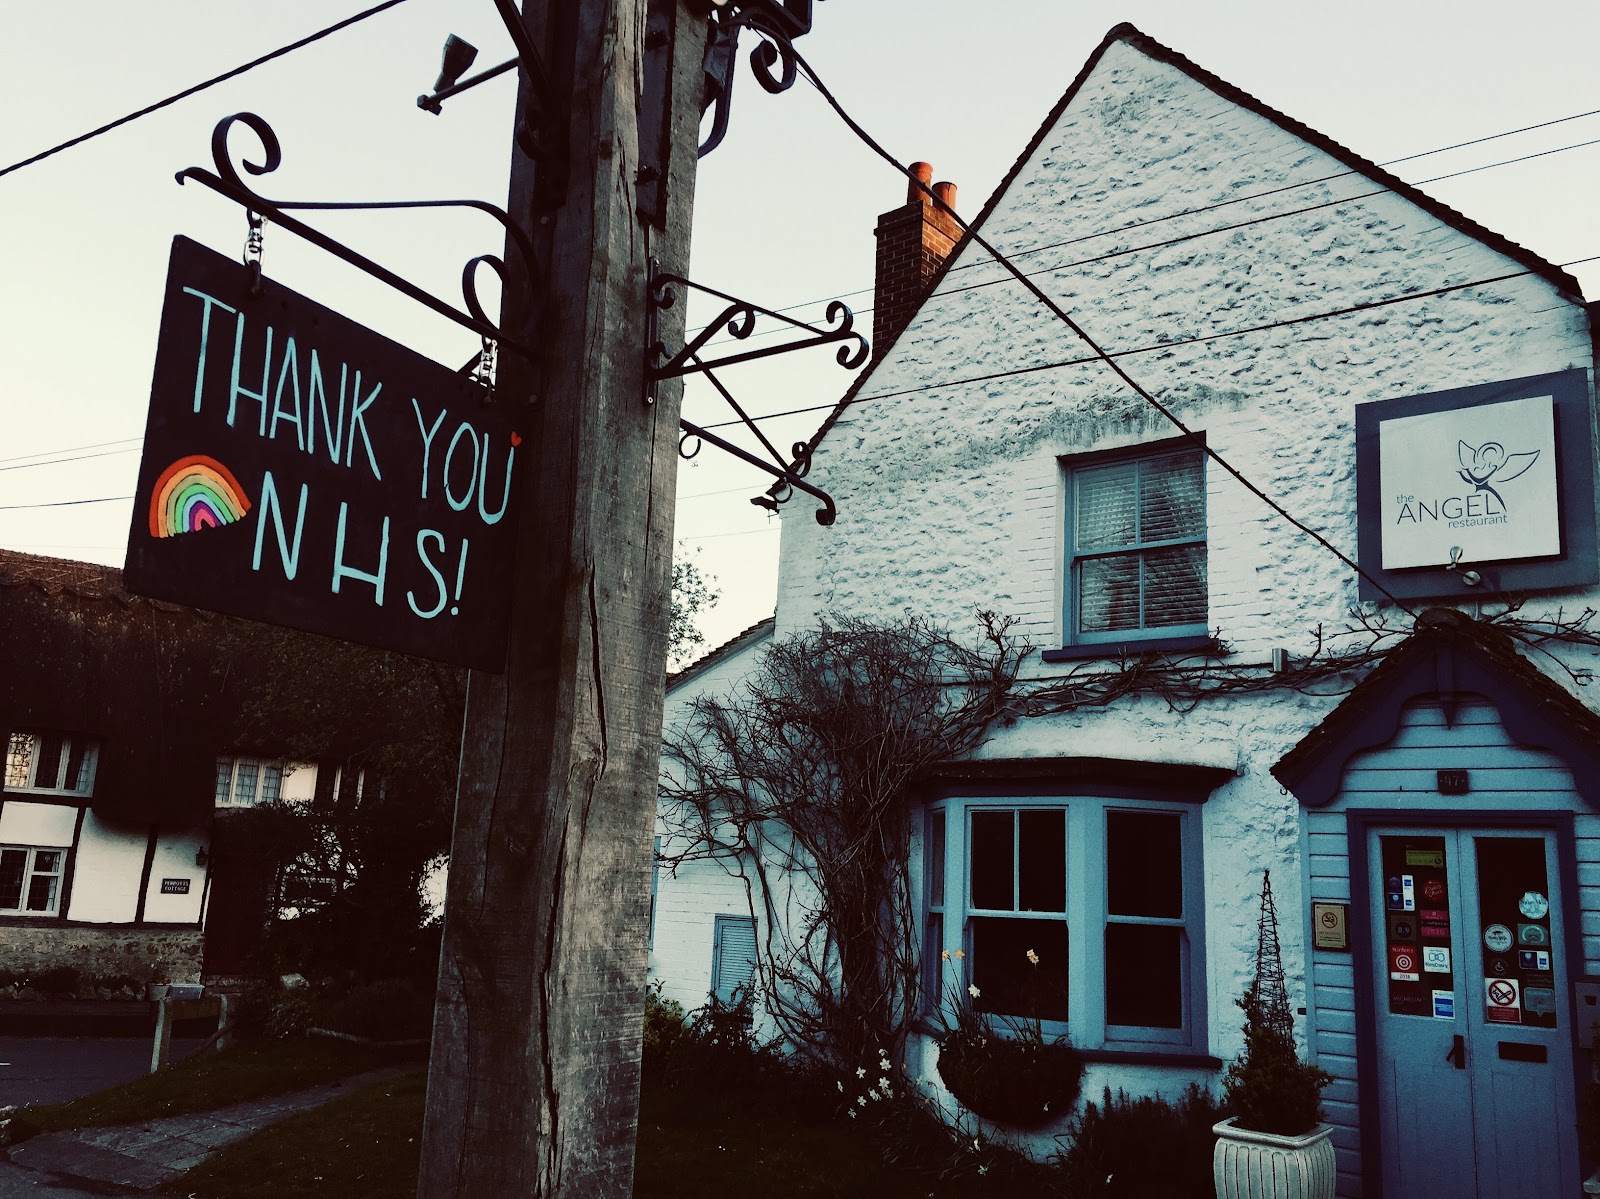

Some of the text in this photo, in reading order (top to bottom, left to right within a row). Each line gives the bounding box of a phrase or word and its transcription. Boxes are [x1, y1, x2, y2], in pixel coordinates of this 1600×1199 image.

[183, 286, 515, 525] THANK YOU
[1396, 494, 1415, 504] the
[1397, 493, 1500, 525] ANGEL
[1448, 514, 1508, 528] restaurant
